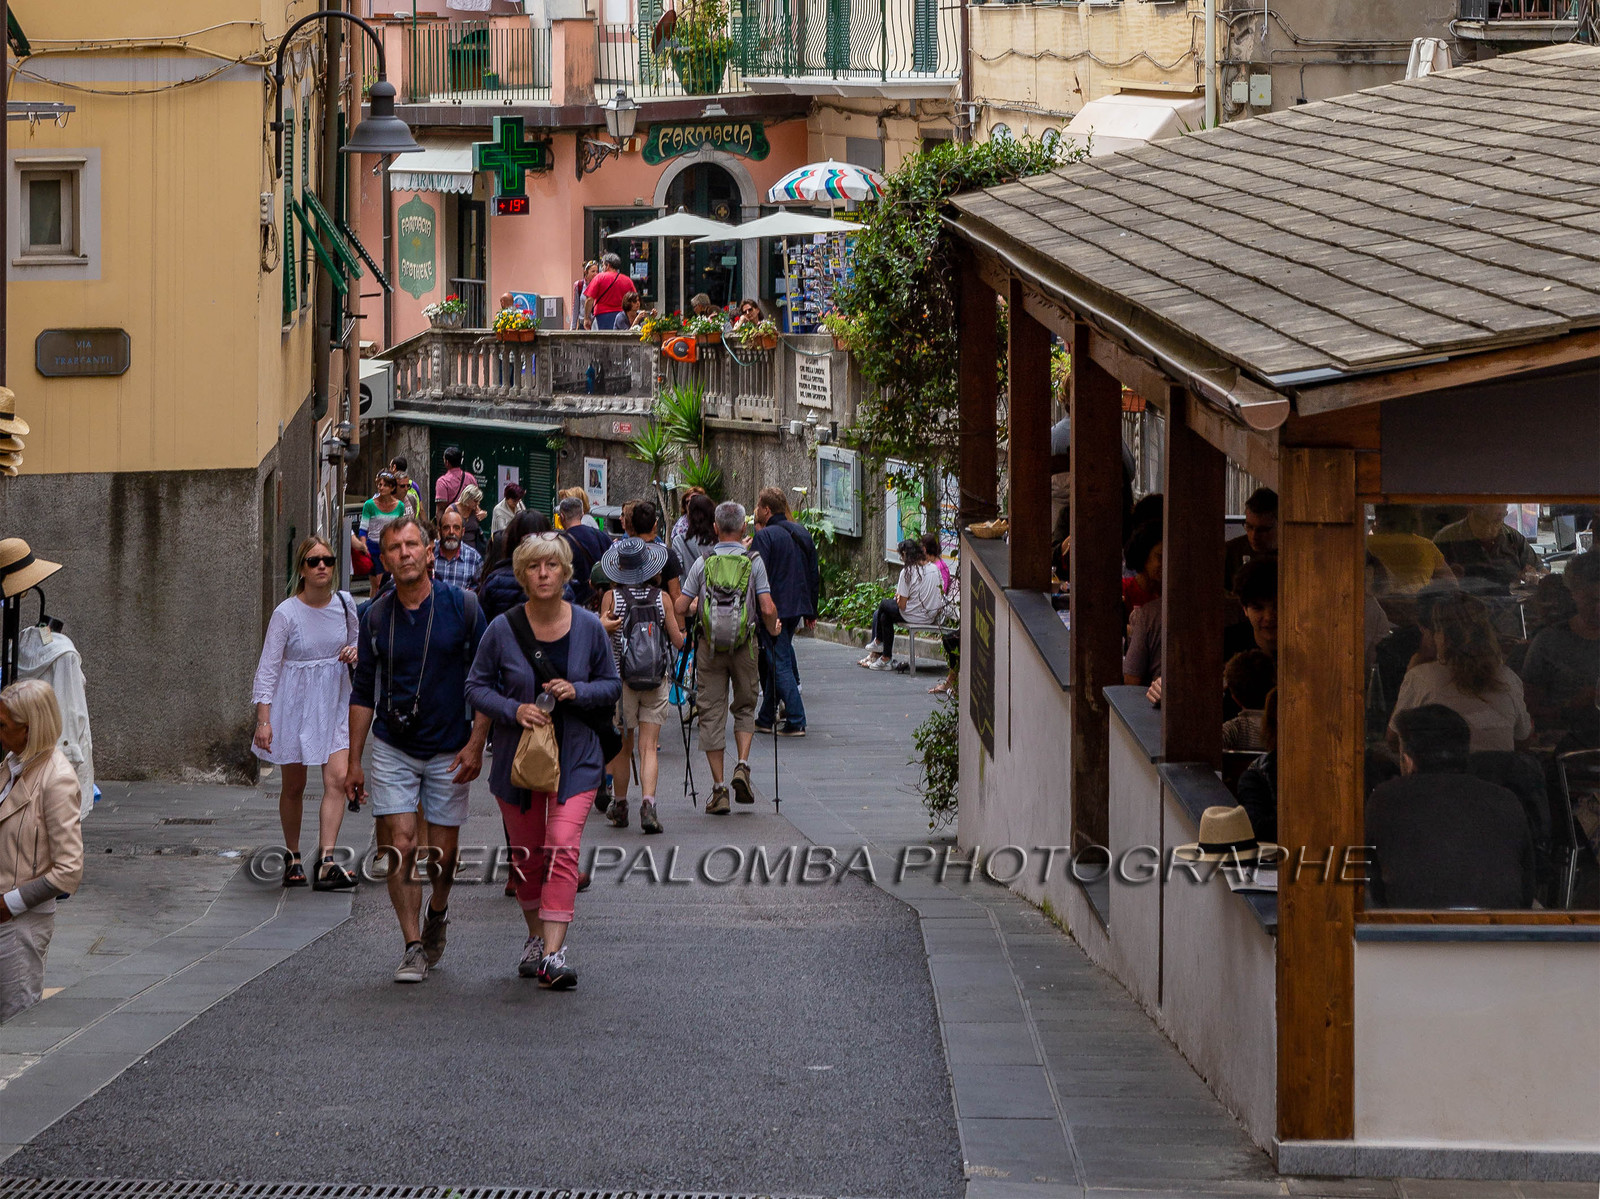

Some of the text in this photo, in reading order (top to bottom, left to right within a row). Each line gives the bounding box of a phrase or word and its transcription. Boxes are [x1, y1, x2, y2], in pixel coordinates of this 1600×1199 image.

[659, 124, 753, 157] FARMACIA
[401, 215, 432, 237] FARMACIA
[401, 258, 433, 280] APOTHEKE
[76, 340, 93, 349] VIA
